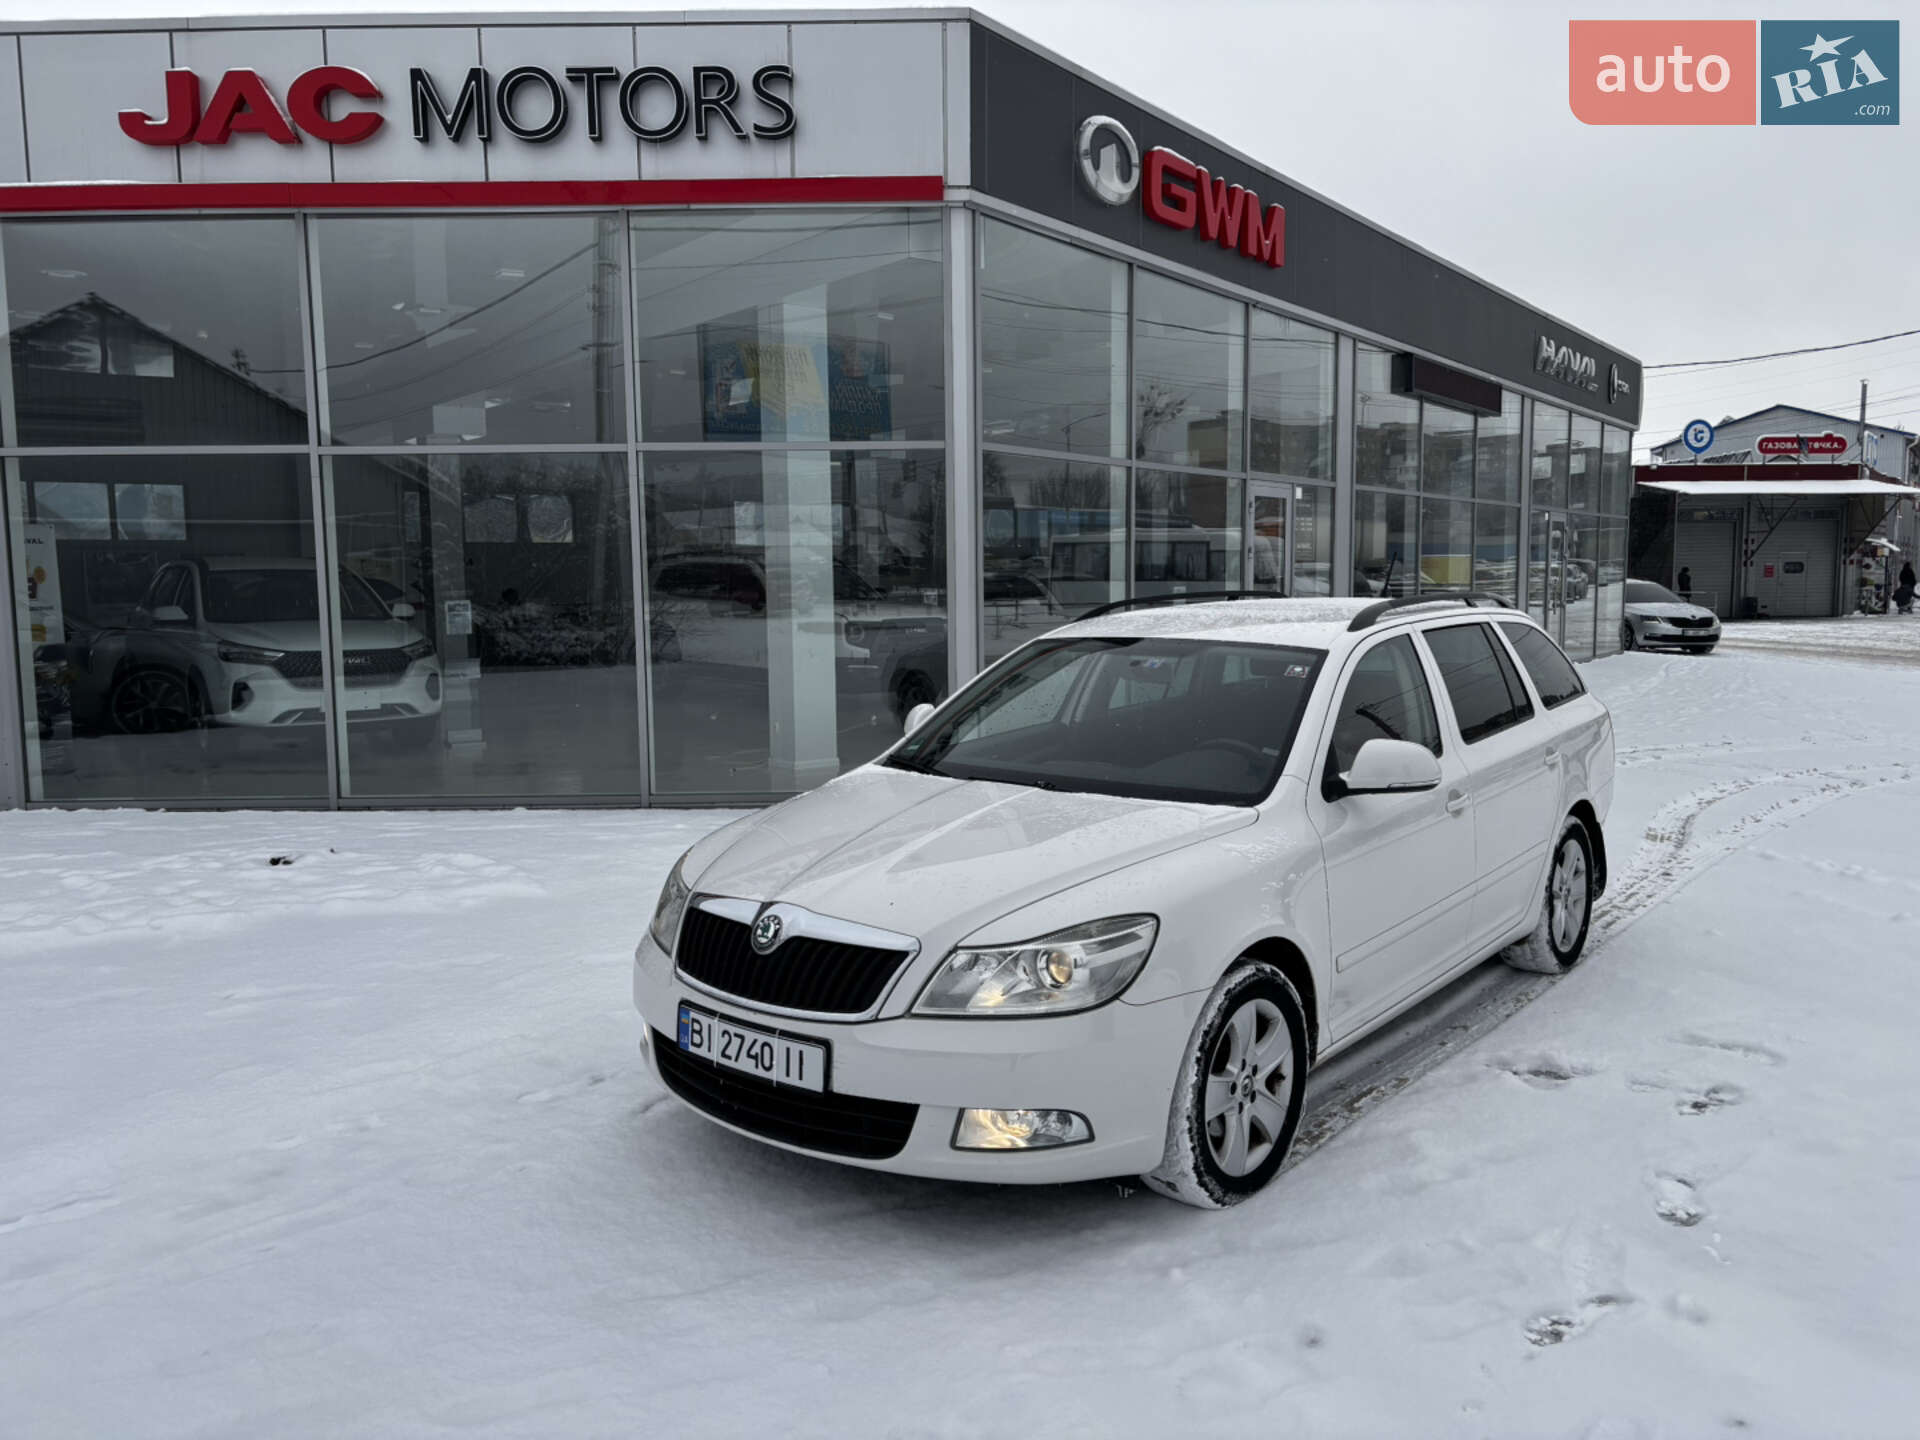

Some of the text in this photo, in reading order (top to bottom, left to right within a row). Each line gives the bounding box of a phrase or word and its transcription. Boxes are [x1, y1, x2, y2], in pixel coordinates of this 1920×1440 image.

[118, 64, 797, 147] JAC MOTORS
[1143, 146, 1286, 268] GWM
[690, 1017, 713, 1053] BI
[721, 1029, 774, 1073] 2740
